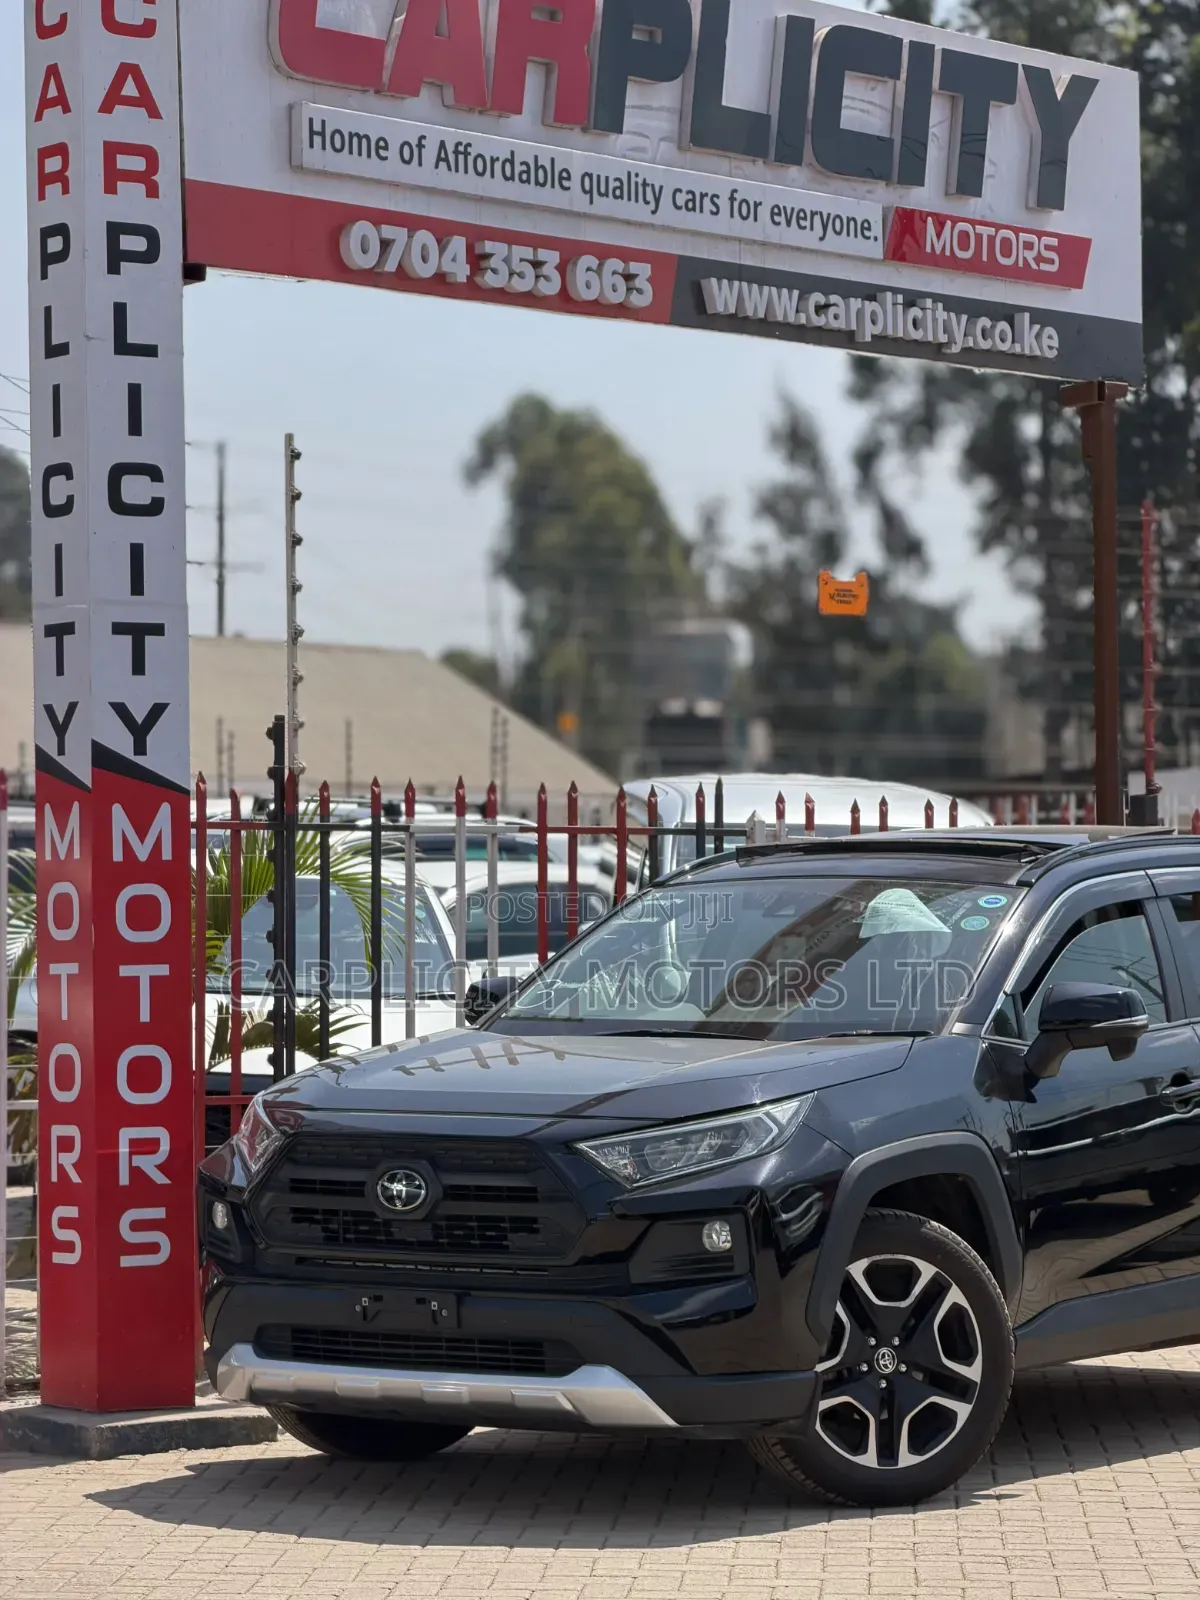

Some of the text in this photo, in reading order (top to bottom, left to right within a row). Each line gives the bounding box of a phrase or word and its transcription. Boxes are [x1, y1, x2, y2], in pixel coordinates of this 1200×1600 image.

[270, 0, 1100, 212] CARPLICITY
[308, 117, 878, 242] Home of Affordable quality cars for everyone.
[340, 220, 653, 309] 0704 353 663
[925, 216, 1060, 273] MOTORS
[700, 277, 1060, 359] www.carplicity.co.ke
[33, 0, 83, 1265] CARPLICITY MOTORS
[97, 0, 173, 1268] CARPLICITY MOTORS
